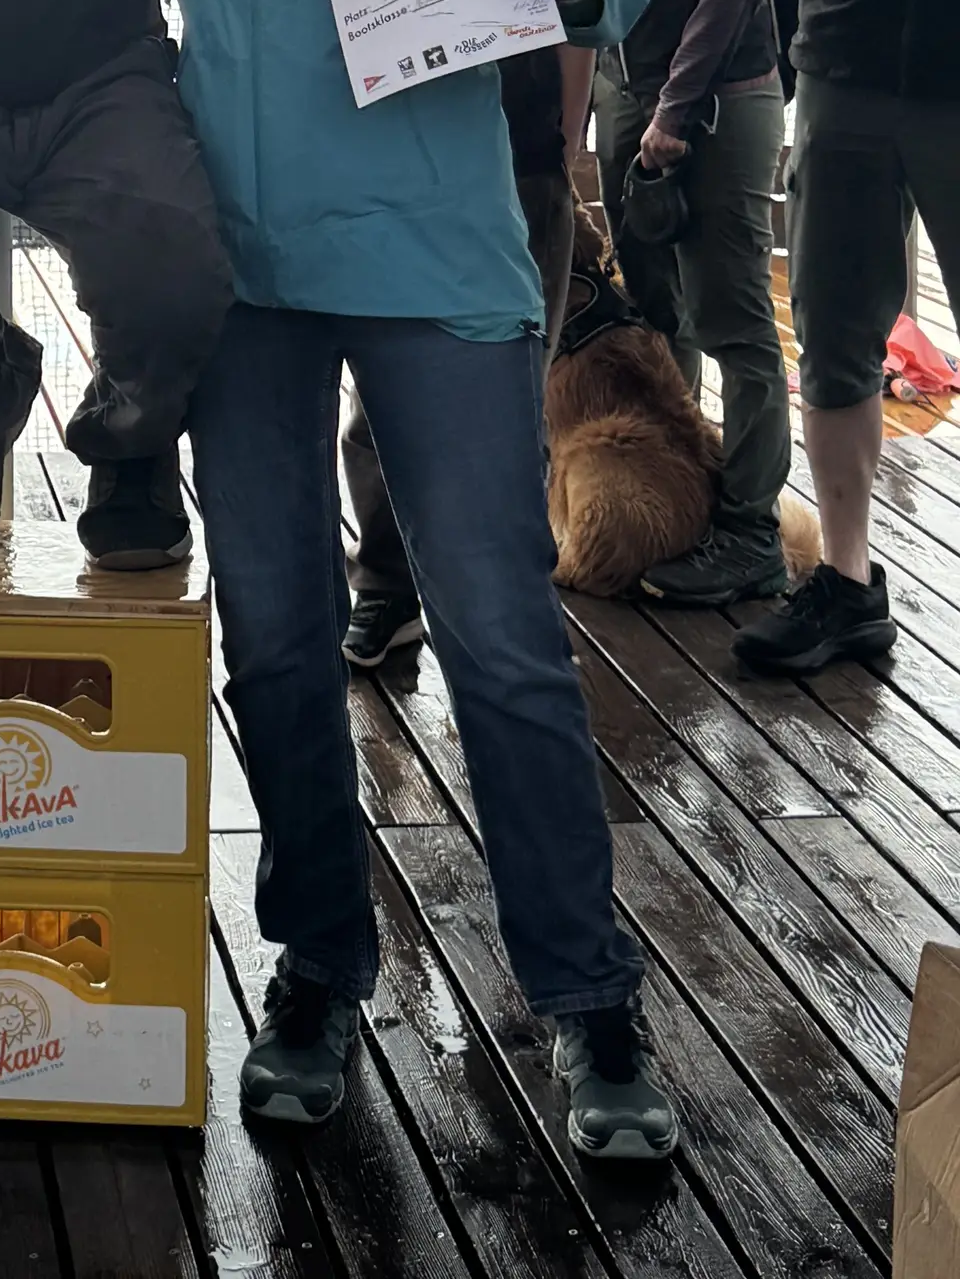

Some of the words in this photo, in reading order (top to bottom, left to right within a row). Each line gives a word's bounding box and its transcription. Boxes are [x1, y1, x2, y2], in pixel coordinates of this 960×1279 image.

[348, 6, 411, 42] Bootsklasse:
[37, 818, 54, 832] ice
[55, 814, 75, 828] tea
